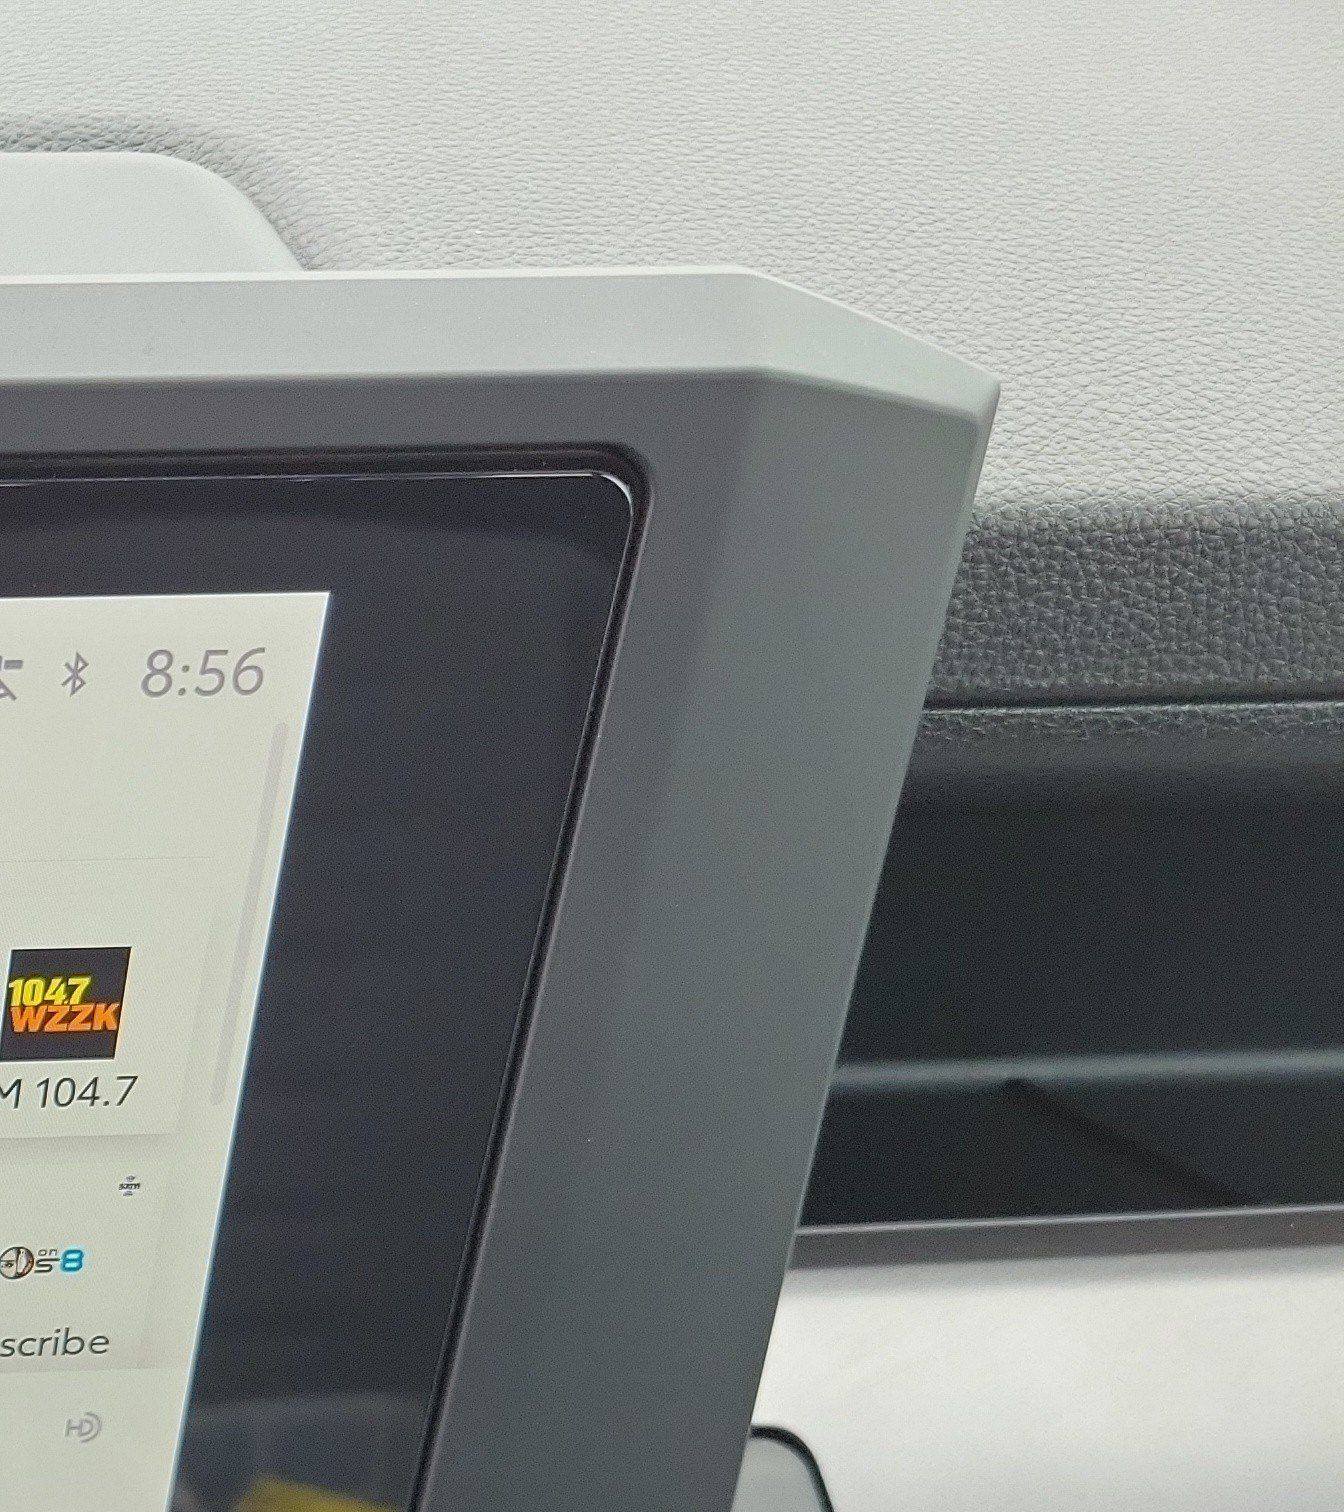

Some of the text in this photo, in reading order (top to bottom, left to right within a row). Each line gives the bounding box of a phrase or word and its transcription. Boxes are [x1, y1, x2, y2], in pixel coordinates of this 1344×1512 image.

[140, 647, 266, 698] 8:56
[11, 1002, 120, 1033] WZZK
[36, 1075, 139, 1109] 104.7
